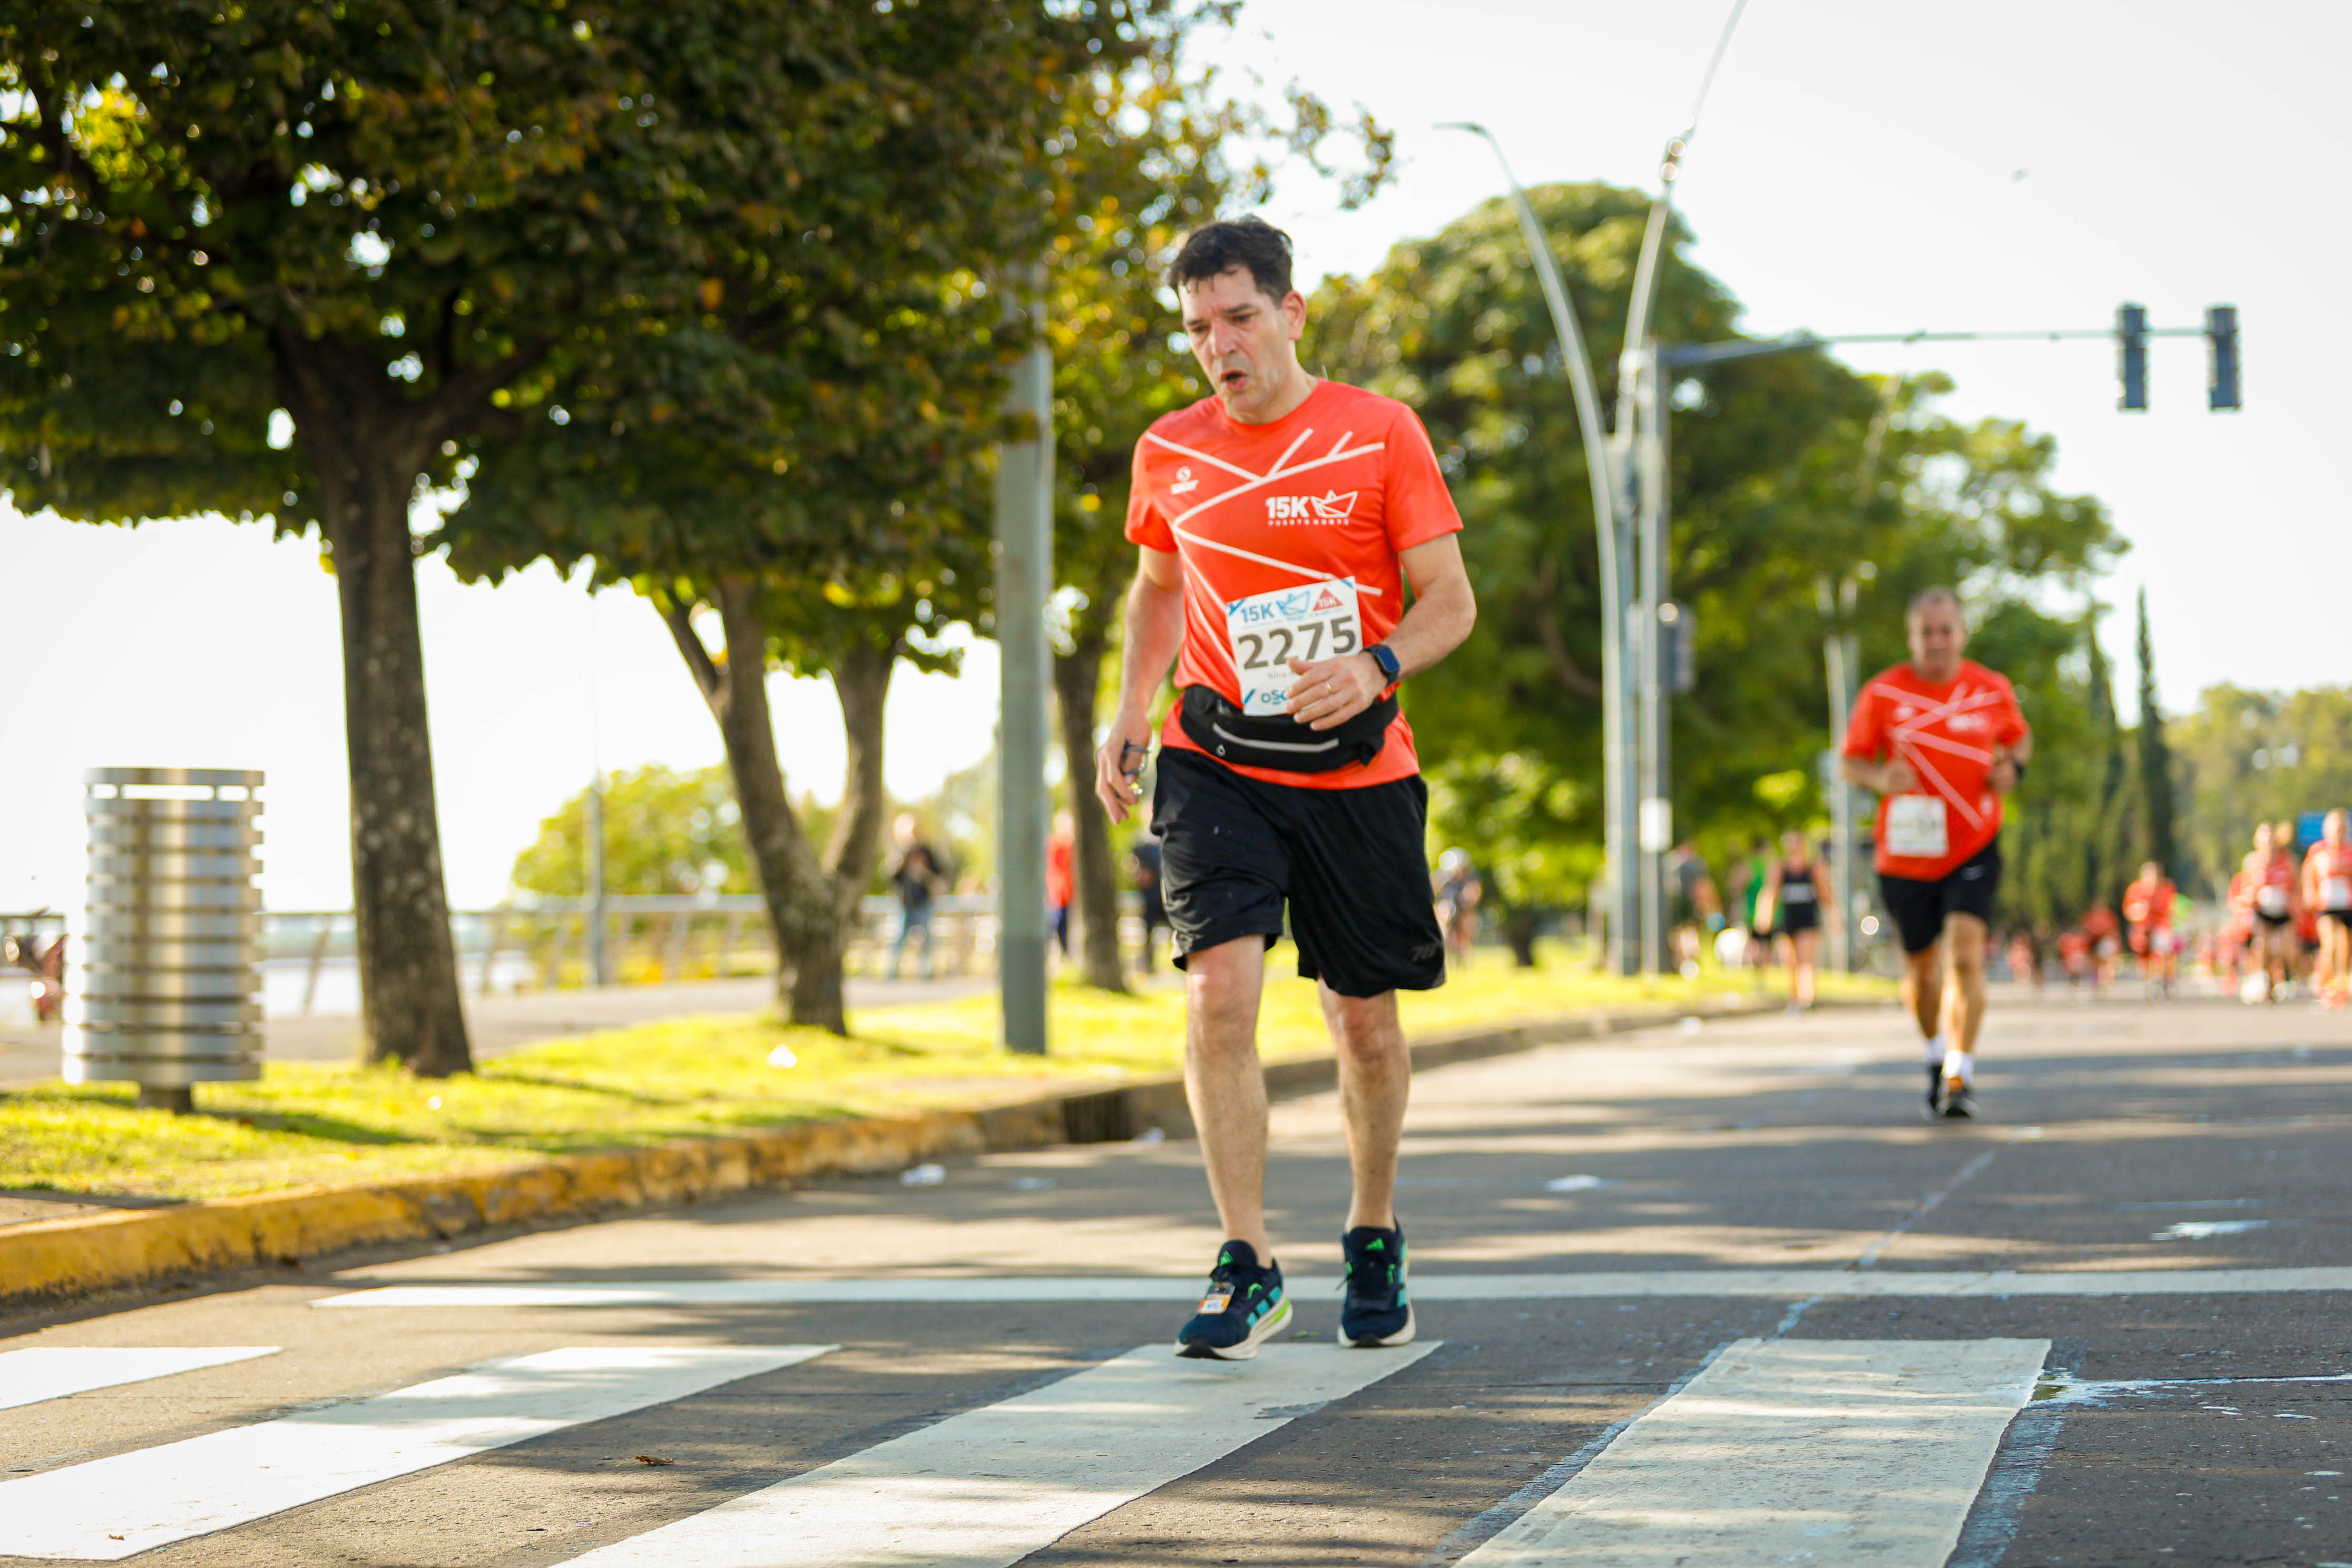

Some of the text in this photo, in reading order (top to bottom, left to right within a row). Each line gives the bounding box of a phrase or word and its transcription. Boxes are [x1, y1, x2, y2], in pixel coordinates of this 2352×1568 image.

[1265, 496, 1310, 519] 15K
[1240, 602, 1275, 623] 15K
[1319, 597, 1337, 607] 15K
[1238, 615, 1357, 670] 2275
